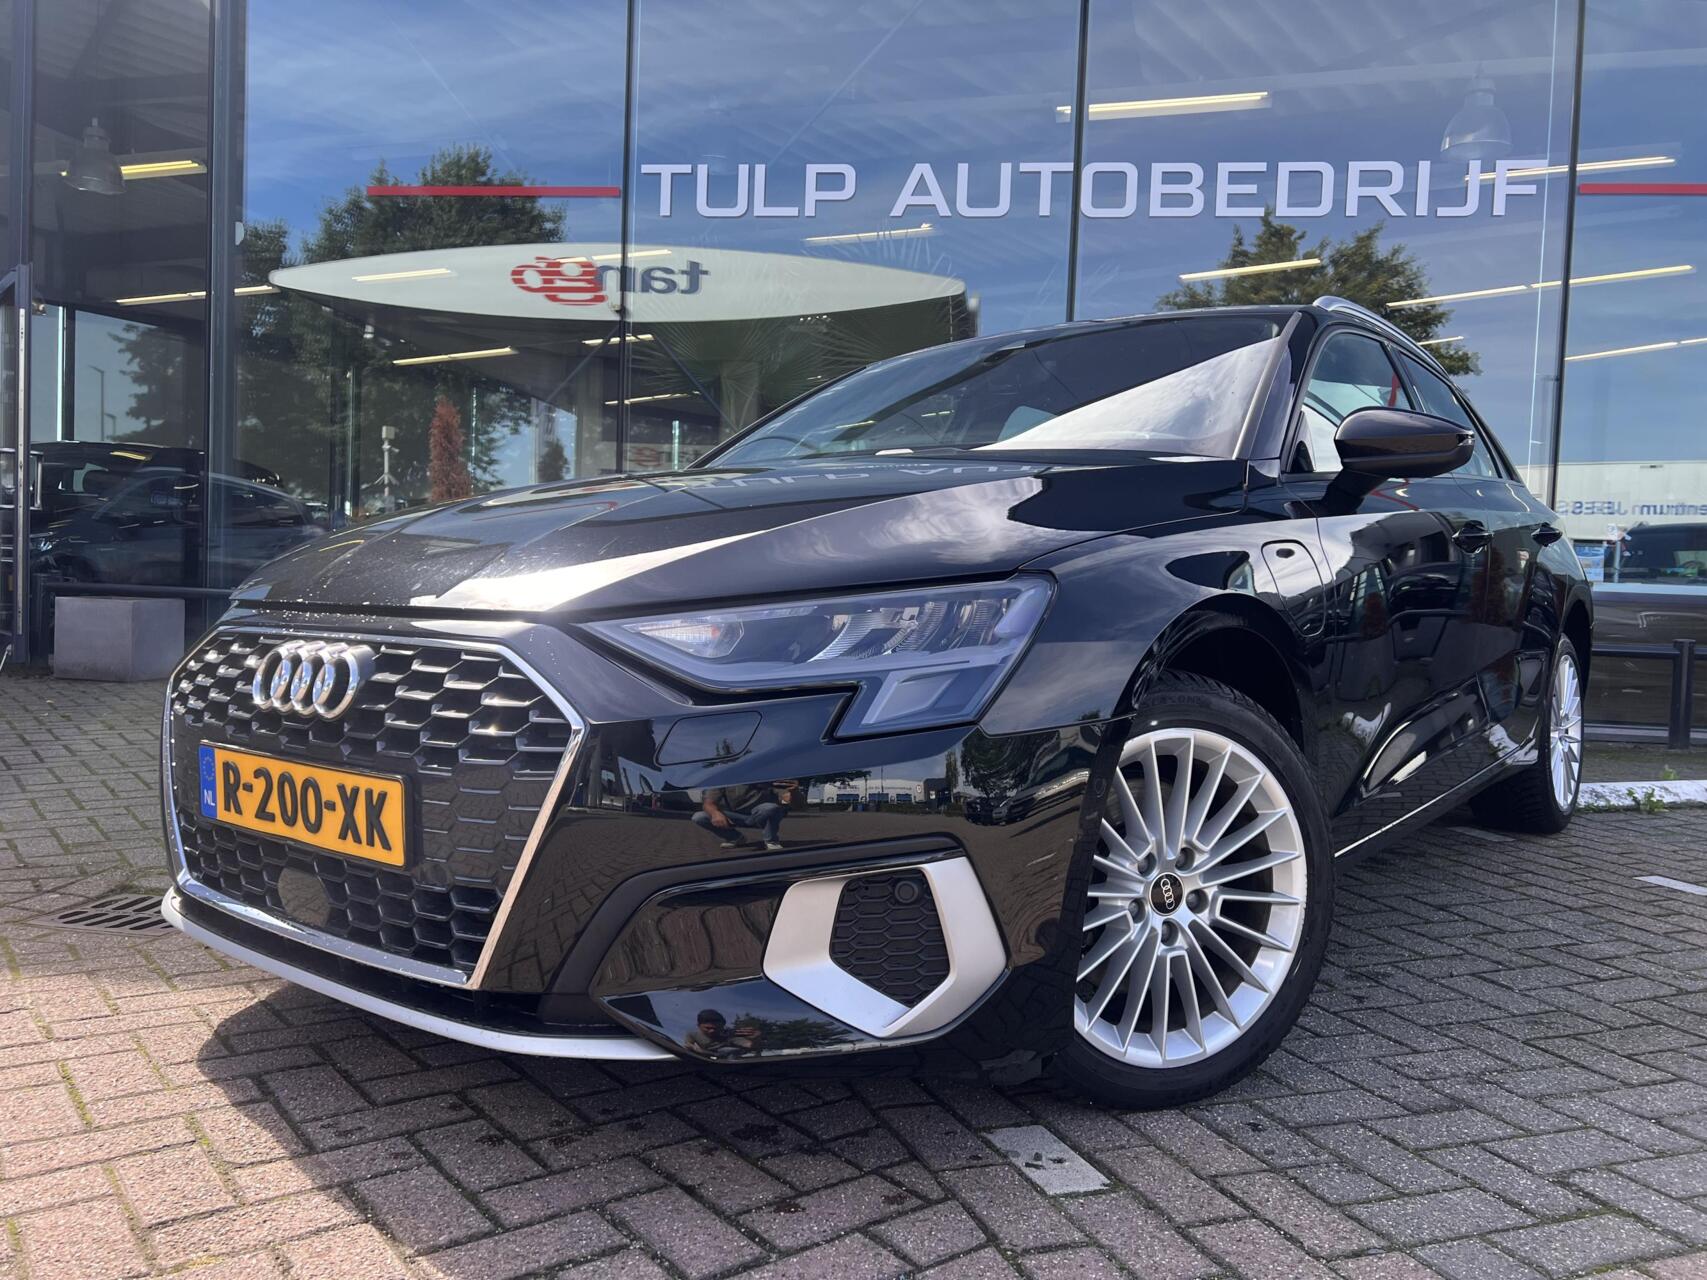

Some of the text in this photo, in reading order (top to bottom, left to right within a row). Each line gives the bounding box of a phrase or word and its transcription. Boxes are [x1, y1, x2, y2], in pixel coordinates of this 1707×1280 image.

[641, 160, 1549, 218] TULP AUTOBEDRIJF
[204, 760, 392, 850] NL R-200-XK
